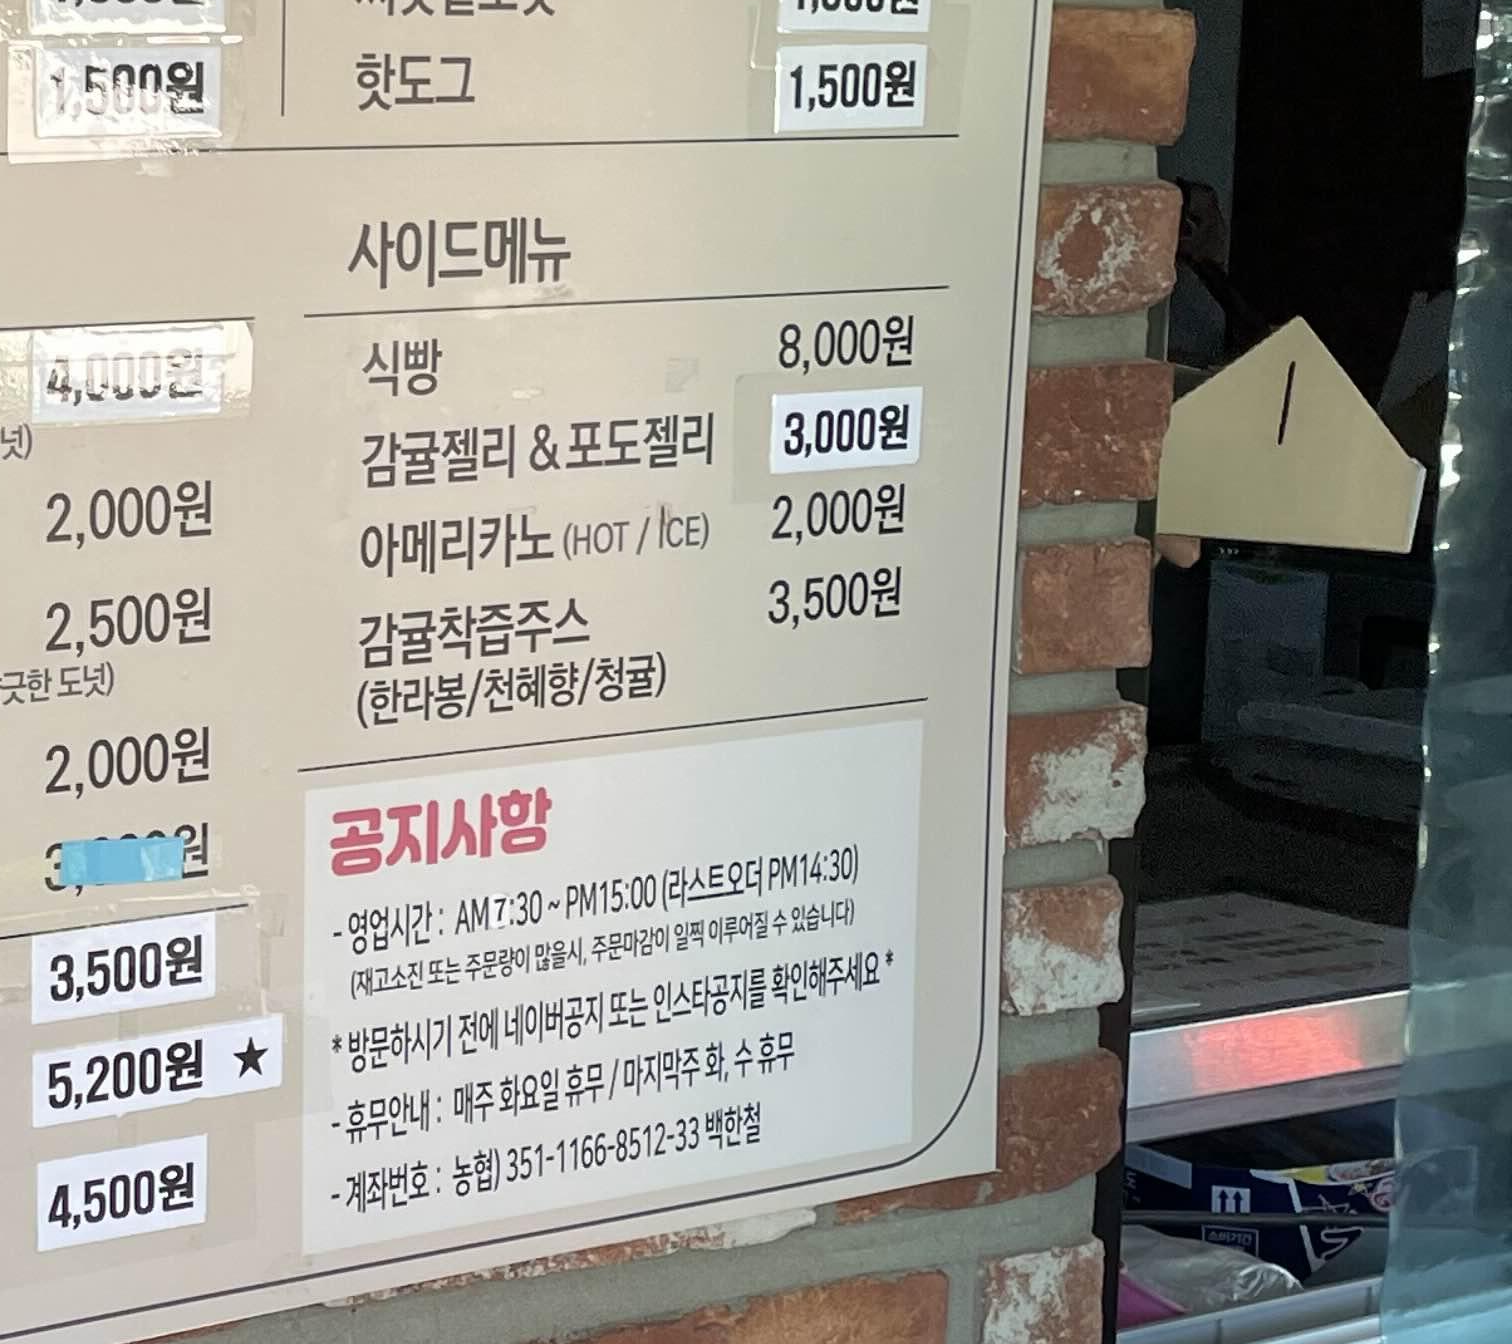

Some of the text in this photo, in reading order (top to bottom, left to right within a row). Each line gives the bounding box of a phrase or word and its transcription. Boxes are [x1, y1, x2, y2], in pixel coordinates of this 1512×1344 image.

[356, 53, 475, 111] 핫도그
[790, 61, 915, 112] 1,500원
[348, 217, 571, 289] 사이드메뉴
[362, 339, 442, 396] 식빵
[779, 315, 913, 375] 8,000원
[362, 413, 713, 488] 감귤젤리 & 포도젤리
[785, 405, 909, 457] 3,000원
[47, 480, 211, 549] 2,000원
[361, 514, 554, 577] 아메리카노
[563, 521, 630, 560] (HOT
[772, 484, 904, 545] 2,000원
[46, 587, 210, 657] 2,500원
[769, 567, 901, 629] 3,500원
[359, 598, 590, 675] 감귤착즙주스
[57, 661, 114, 697] 도넛)
[46, 726, 209, 799] 2,000원
[44, 822, 211, 896] 3,원
[329, 787, 553, 877] 공지사항
[349, 844, 858, 955] 영업시간 AM7:30 PM15:00 (라스트오더 PM14:30)
[51, 935, 202, 1002] 3,500원
[351, 898, 854, 999] (재고소진 또는 주문량이 많을시, 주문마감이 일찍 이루어질 수 있습니다)
[349, 952, 880, 1073] 방문하시기 전에 네이버공지 또는 인스타공지를 확인해주세요
[49, 1039, 202, 1109] 5,200원
[346, 1089, 429, 1144] 휴무안내
[454, 1081, 494, 1124] 매주
[499, 1068, 558, 1116] 화요일
[565, 1063, 604, 1107] 휴무
[624, 1047, 700, 1096] 마지막주
[734, 1039, 753, 1077] 수
[757, 1032, 794, 1074] 휴무
[346, 1102, 760, 1213] 계좌번호 농협) 351-1166-8512-33 백한철
[48, 1162, 193, 1230] 4,500원
